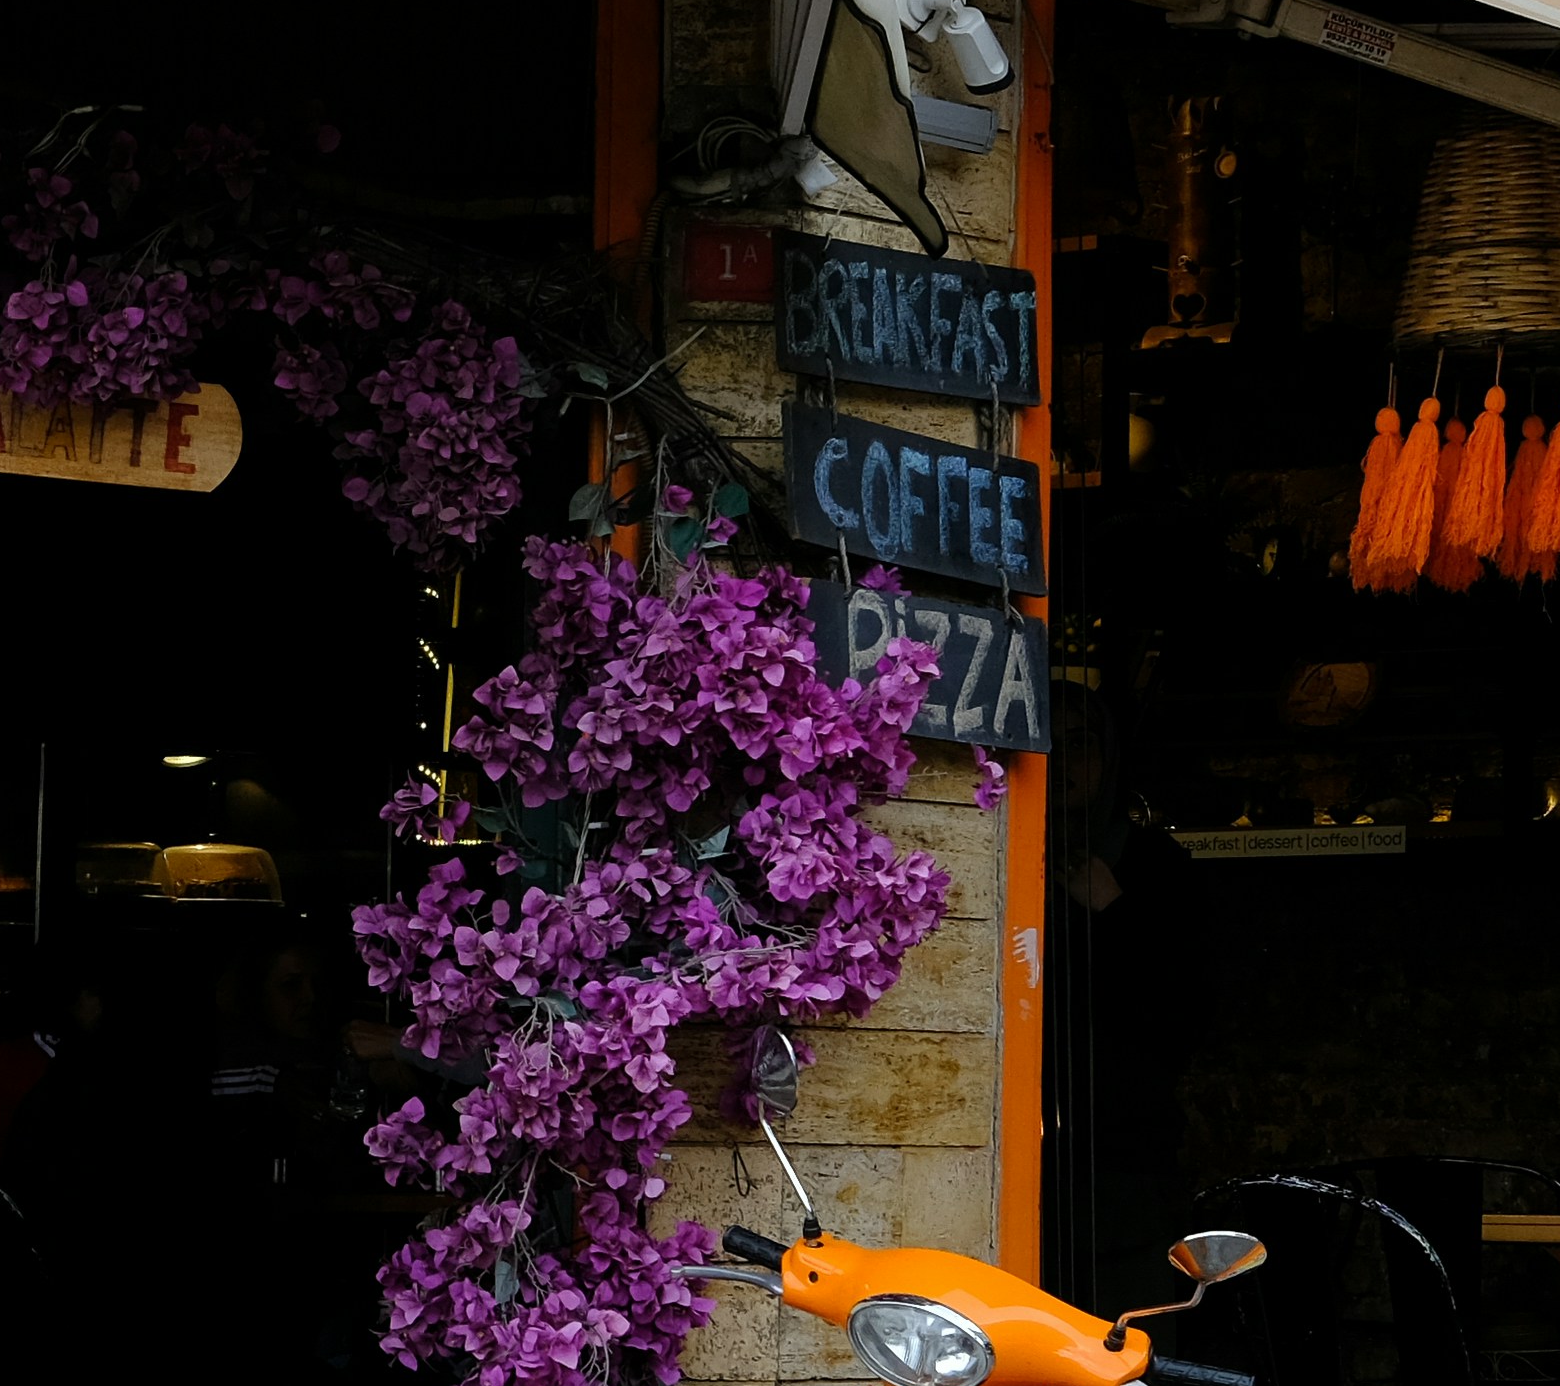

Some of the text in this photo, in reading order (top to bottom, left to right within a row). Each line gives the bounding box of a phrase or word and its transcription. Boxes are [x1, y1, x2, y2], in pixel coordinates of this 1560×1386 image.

[783, 248, 1037, 391] BREAKFAST
[813, 436, 1029, 574] COFFEE
[1247, 834, 1304, 851] dessert
[1310, 832, 1359, 849] coffee
[1366, 831, 1403, 847] food
